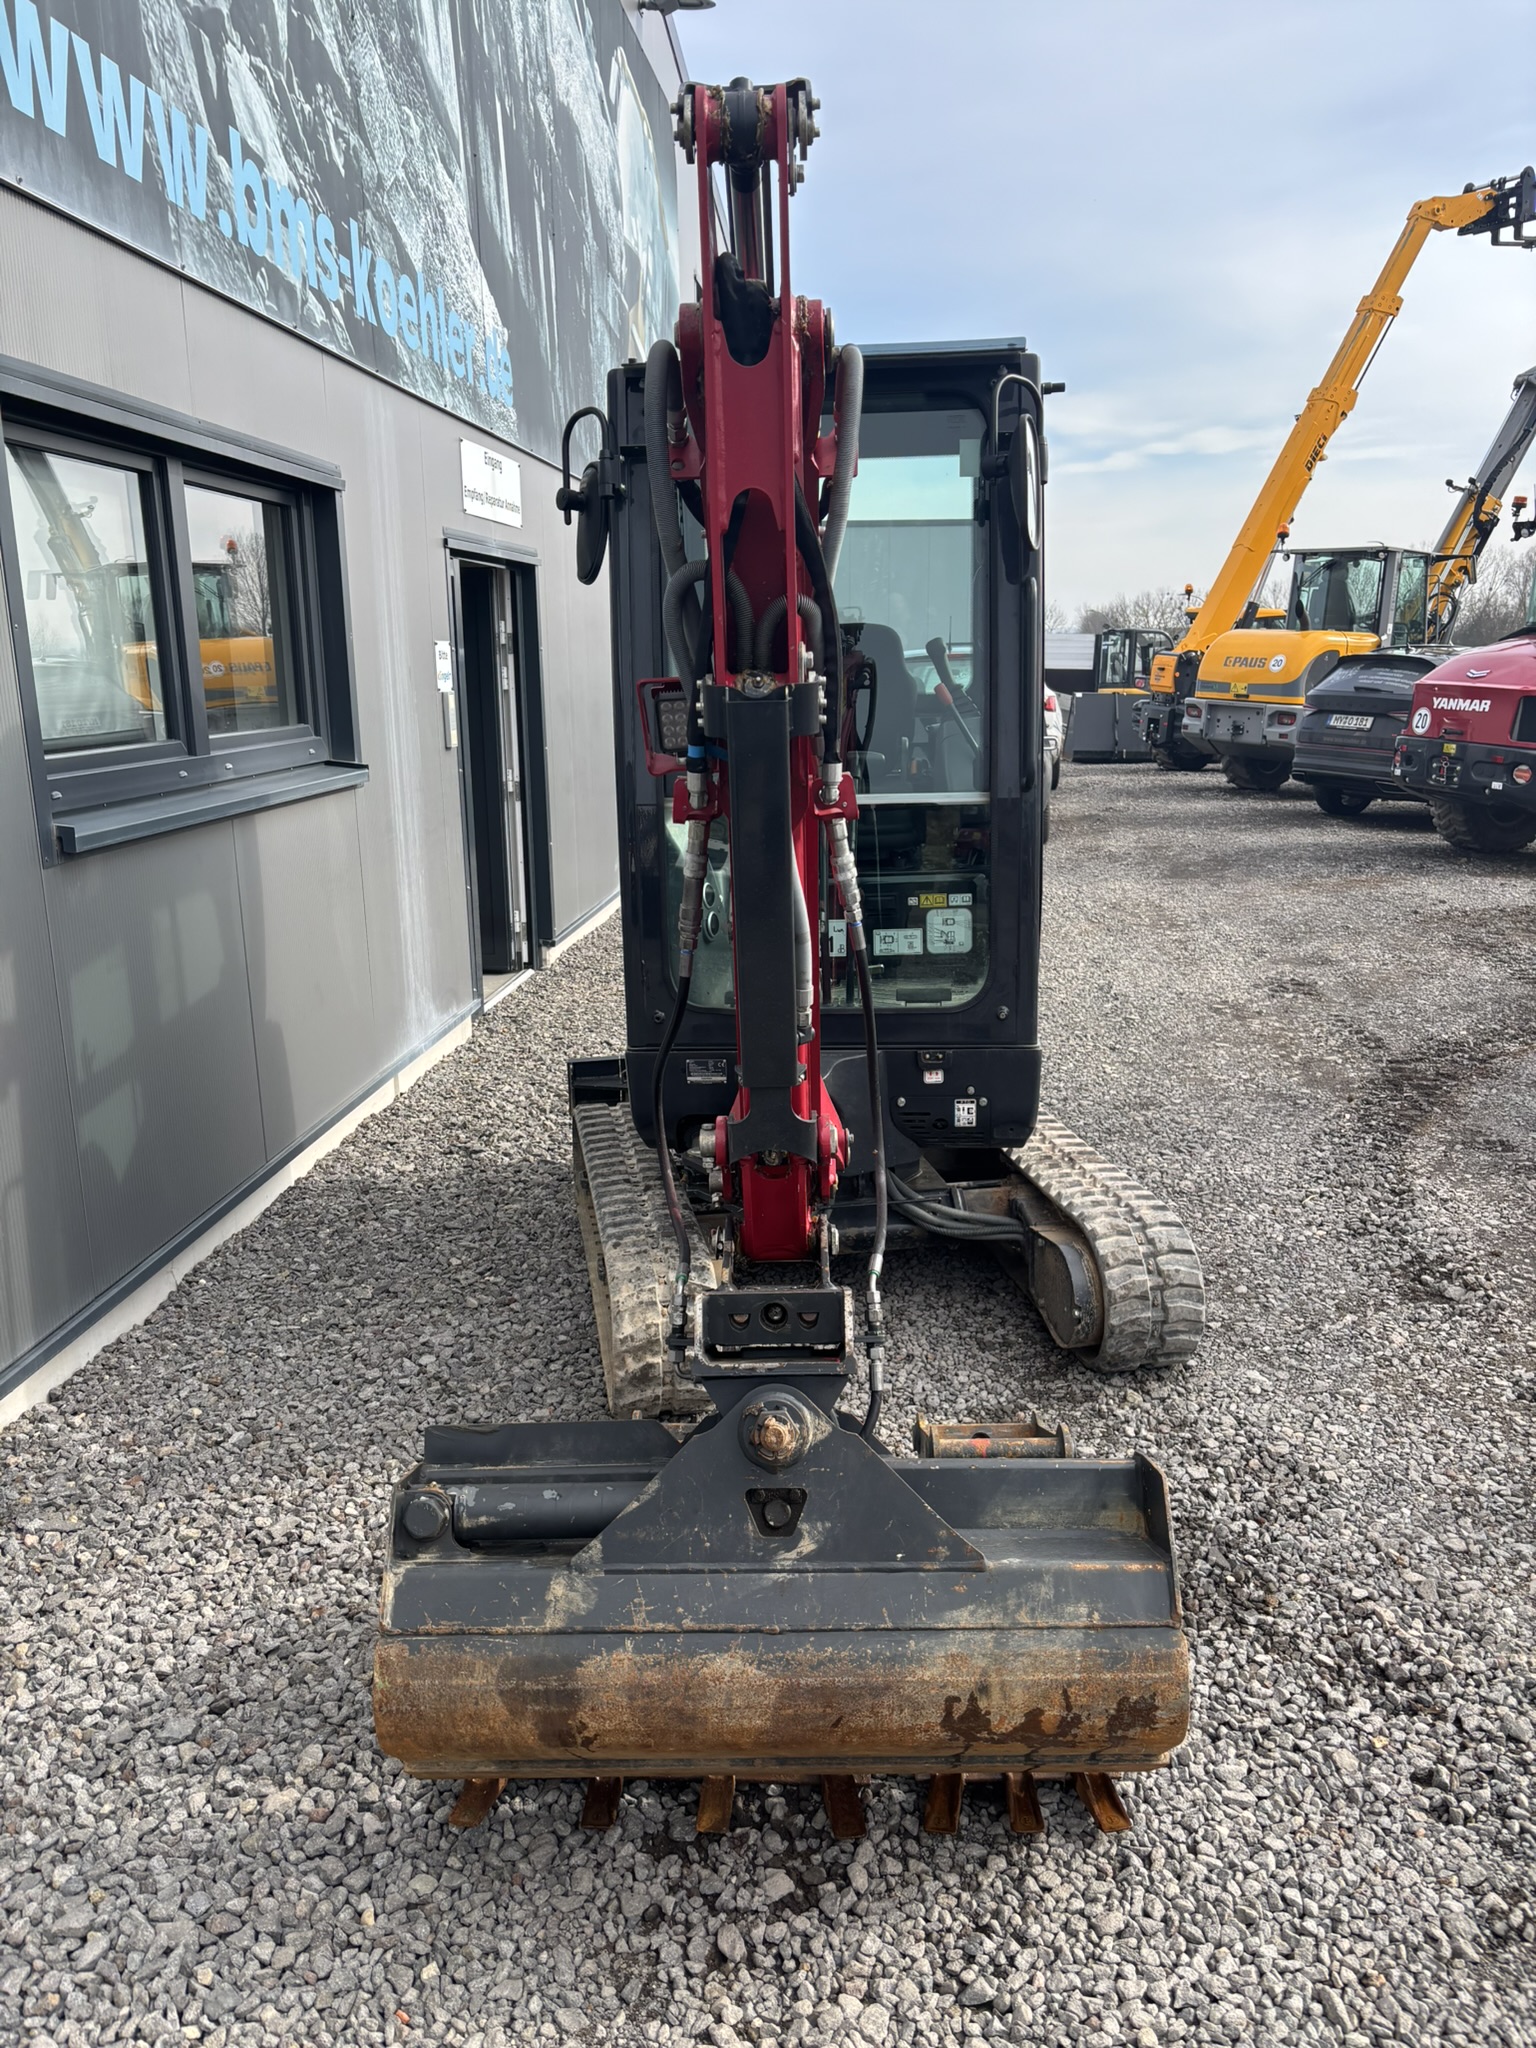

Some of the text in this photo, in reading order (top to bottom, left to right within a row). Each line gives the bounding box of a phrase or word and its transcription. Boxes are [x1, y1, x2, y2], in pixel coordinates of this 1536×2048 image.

[0, 0, 514, 407] www.bms-koehler.de
[484, 451, 503, 475] Eingang
[1305, 433, 1328, 473] DIECI
[1272, 659, 1283, 668] 20
[1432, 697, 1492, 712] YANMAR
[1415, 712, 1429, 730] 20
